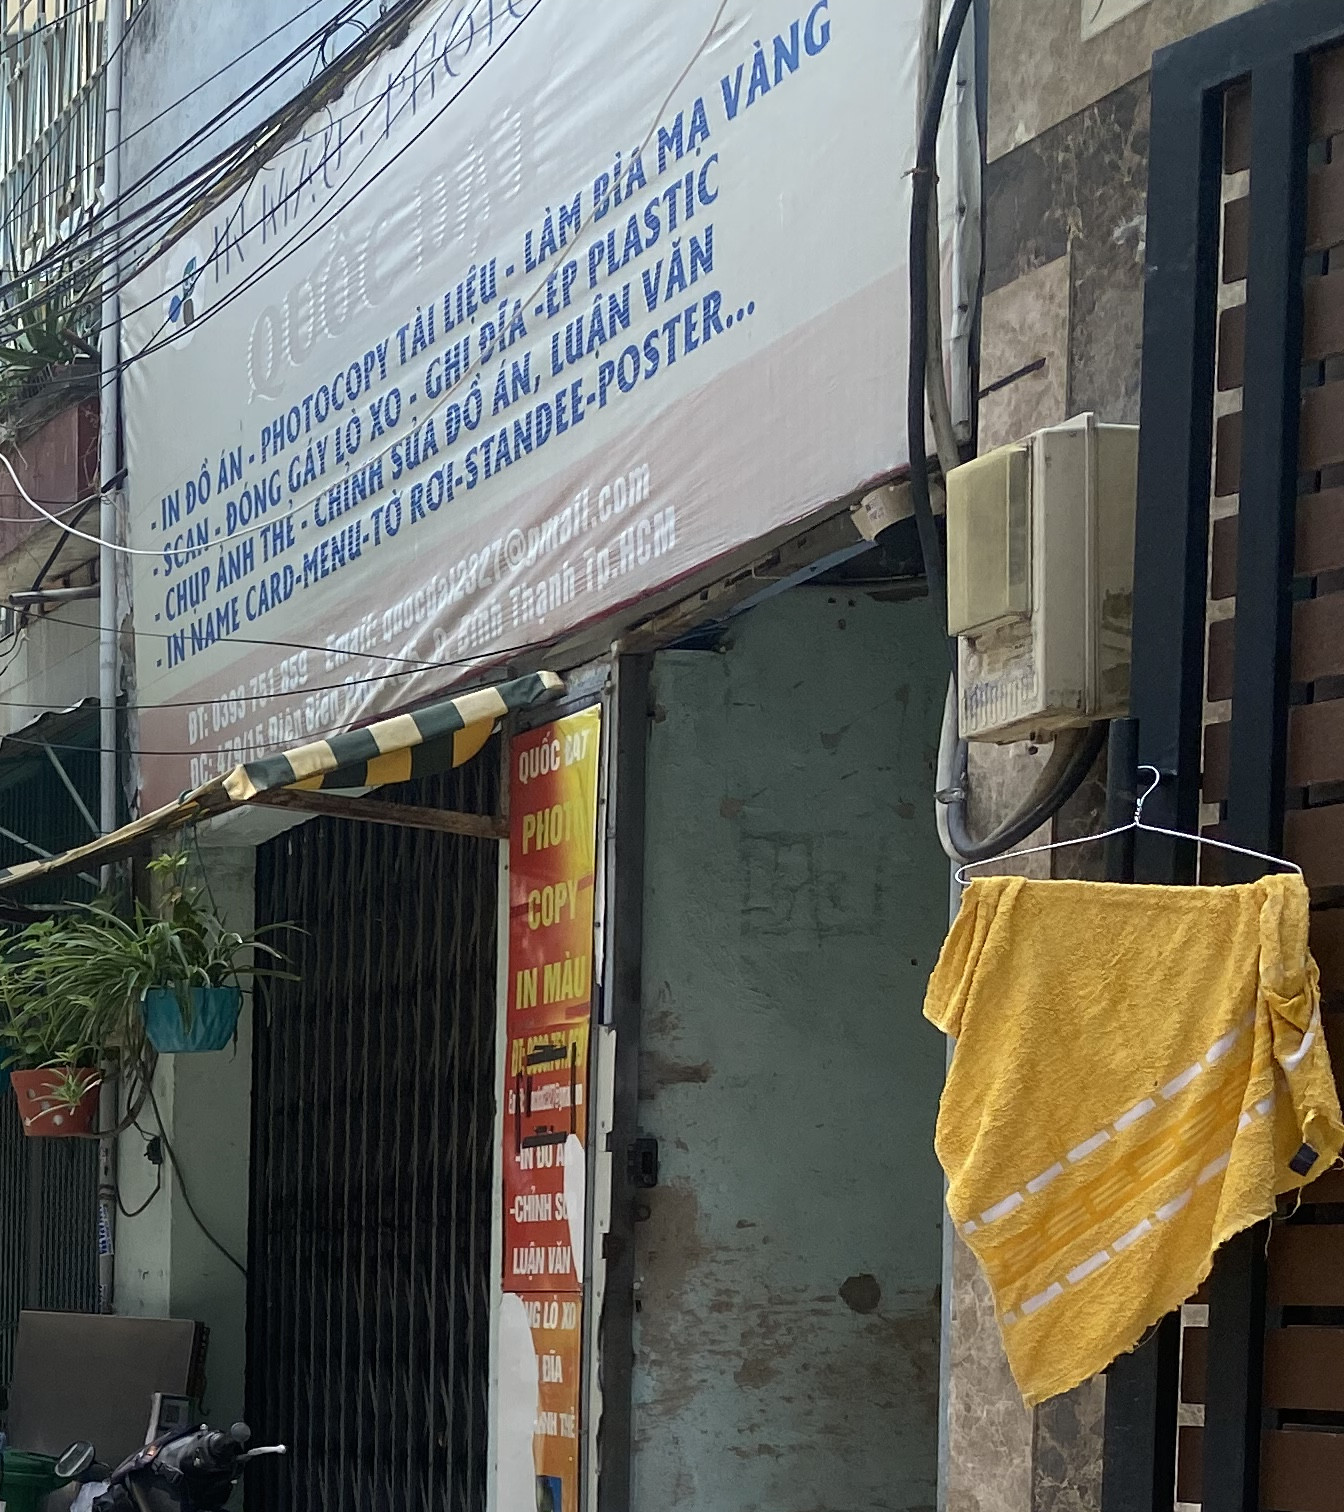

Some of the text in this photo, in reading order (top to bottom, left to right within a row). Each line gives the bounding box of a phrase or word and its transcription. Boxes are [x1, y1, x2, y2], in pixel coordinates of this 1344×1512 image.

[161, 489, 180, 531] IN
[186, 457, 211, 515] ĐỒ
[217, 445, 243, 495] ÁN
[261, 337, 389, 464] PHOTOCOPY
[396, 304, 435, 366] TÀI
[443, 257, 497, 333] LIỆU
[524, 190, 583, 274] LÀM
[656, 96, 711, 175] MẠ
[719, 0, 832, 121] VÀNG
[164, 518, 209, 577] SCAN
[226, 469, 282, 537] ĐÓNG
[289, 434, 328, 493] GÁY
[335, 408, 361, 465] LÒ
[369, 387, 402, 441] XO
[425, 334, 471, 400] GHI
[587, 152, 720, 290] PLASTIC
[165, 566, 211, 624] CHỤP
[216, 541, 255, 593] ẢNH
[260, 499, 296, 564] THẺ
[313, 458, 384, 527] CHỈNH
[391, 416, 440, 480] SỬA
[445, 372, 482, 446] ĐỒ
[491, 350, 541, 417] ÁN,
[551, 283, 631, 377] LUẬN
[641, 223, 715, 313] VĂN
[167, 628, 185, 669] IN
[191, 595, 240, 657] NAME
[212, 685, 247, 732] 0393
[250, 668, 275, 713] 751
[518, 731, 561, 785] QUỐC
[527, 886, 579, 931] COPY
[515, 950, 586, 1010] IN MÀU
[513, 1240, 572, 1281] LUẬN VĂN
